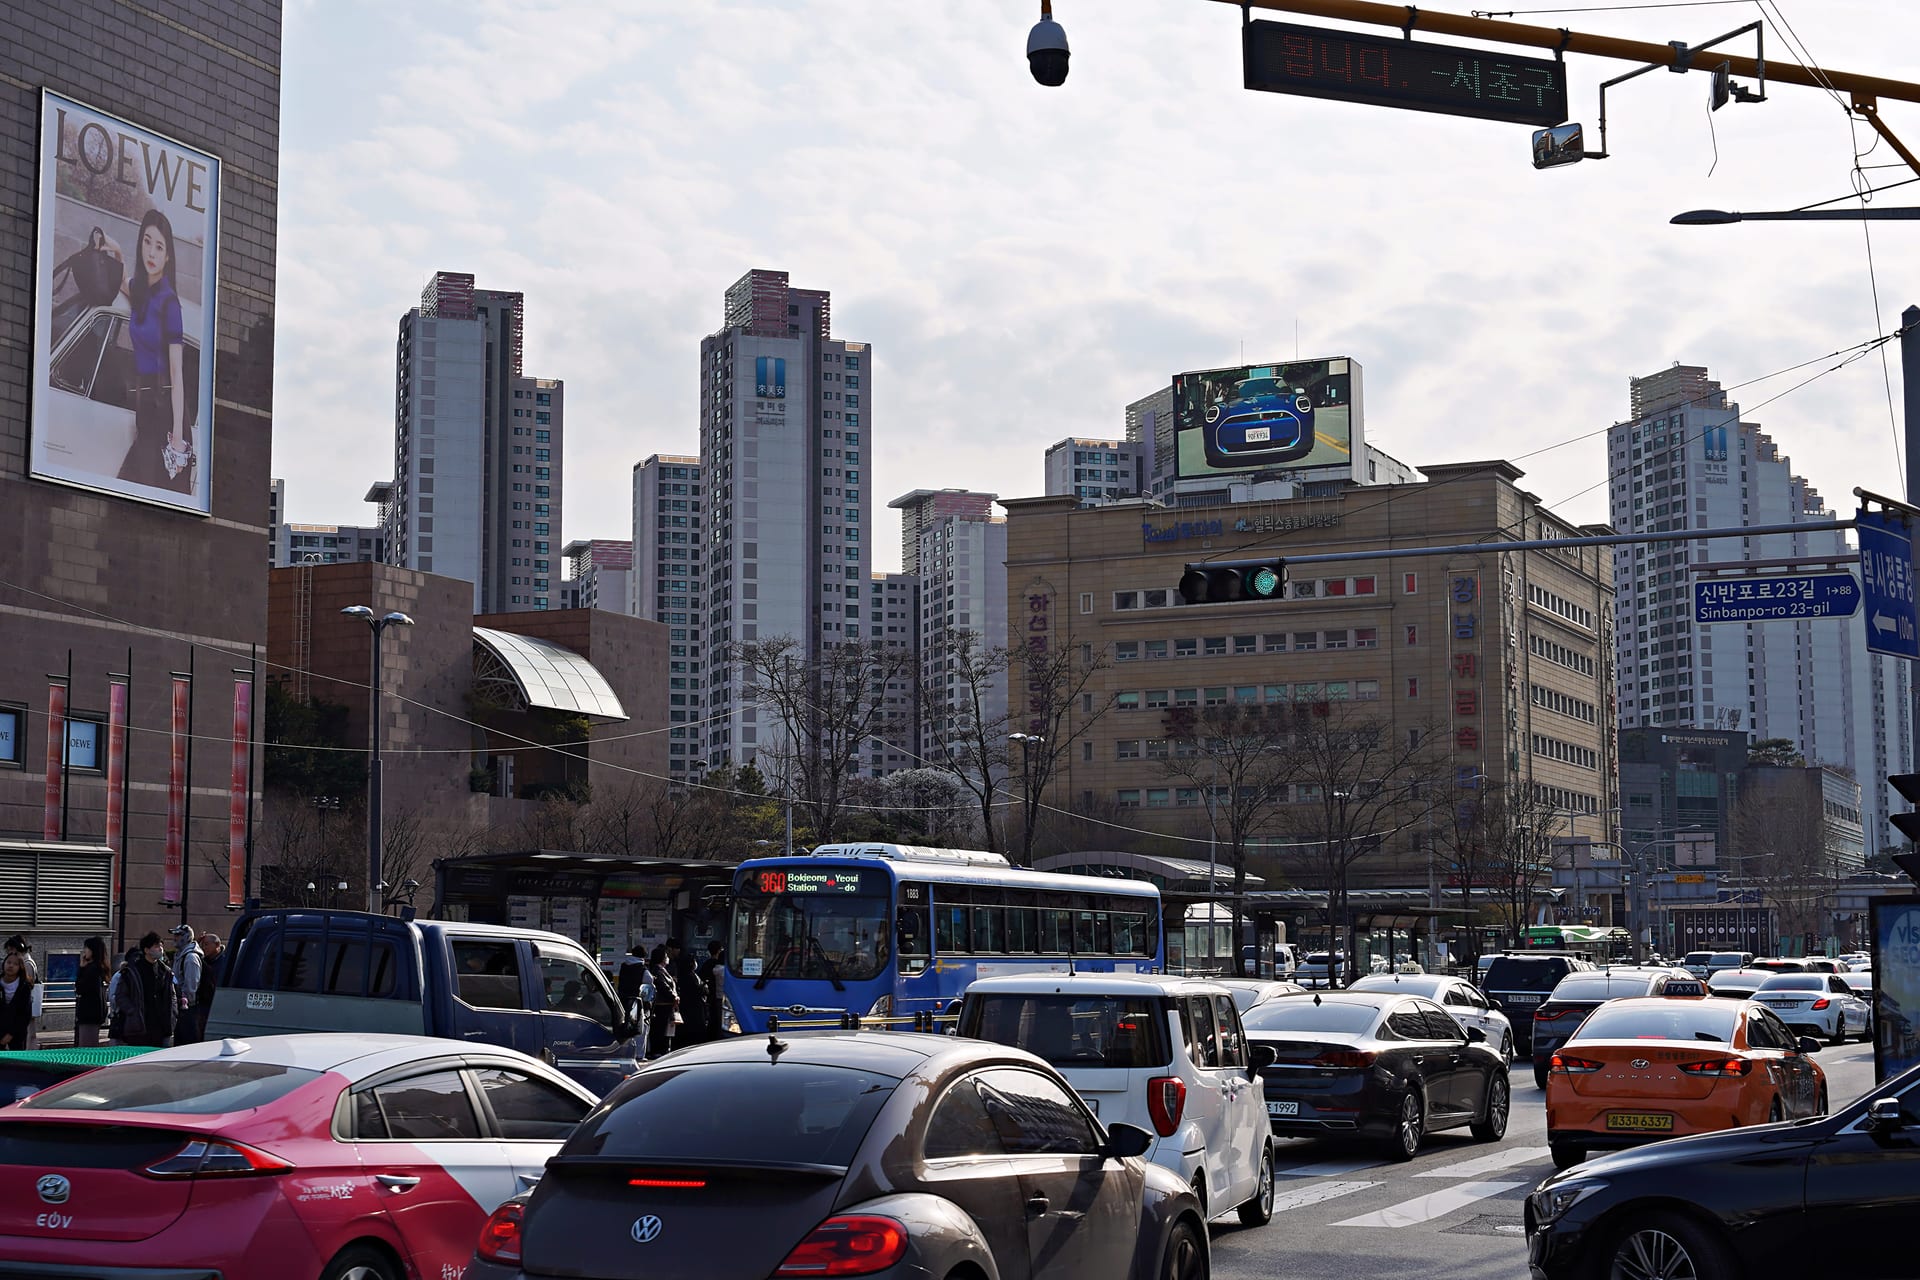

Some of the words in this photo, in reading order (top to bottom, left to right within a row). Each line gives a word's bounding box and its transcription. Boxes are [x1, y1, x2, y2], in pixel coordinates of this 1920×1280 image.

[54, 108, 207, 213] LOEWE
[1863, 549, 1914, 603] 택시정류장
[1701, 580, 1814, 604] 신반포로23길
[1700, 606, 1786, 619] Sinbanpo-ro
[1790, 602, 1830, 616] 23-gil
[70, 738, 91, 749] OEWE
[760, 872, 786, 893] 360
[787, 873, 827, 882] Bokjeong
[835, 873, 859, 882] Yeoui
[787, 884, 818, 892] Station
[906, 888, 919, 899] 1883
[1669, 984, 1697, 993] TAXI
[1274, 1103, 1297, 1114] 1992
[1641, 1116, 1668, 1127] 6337
